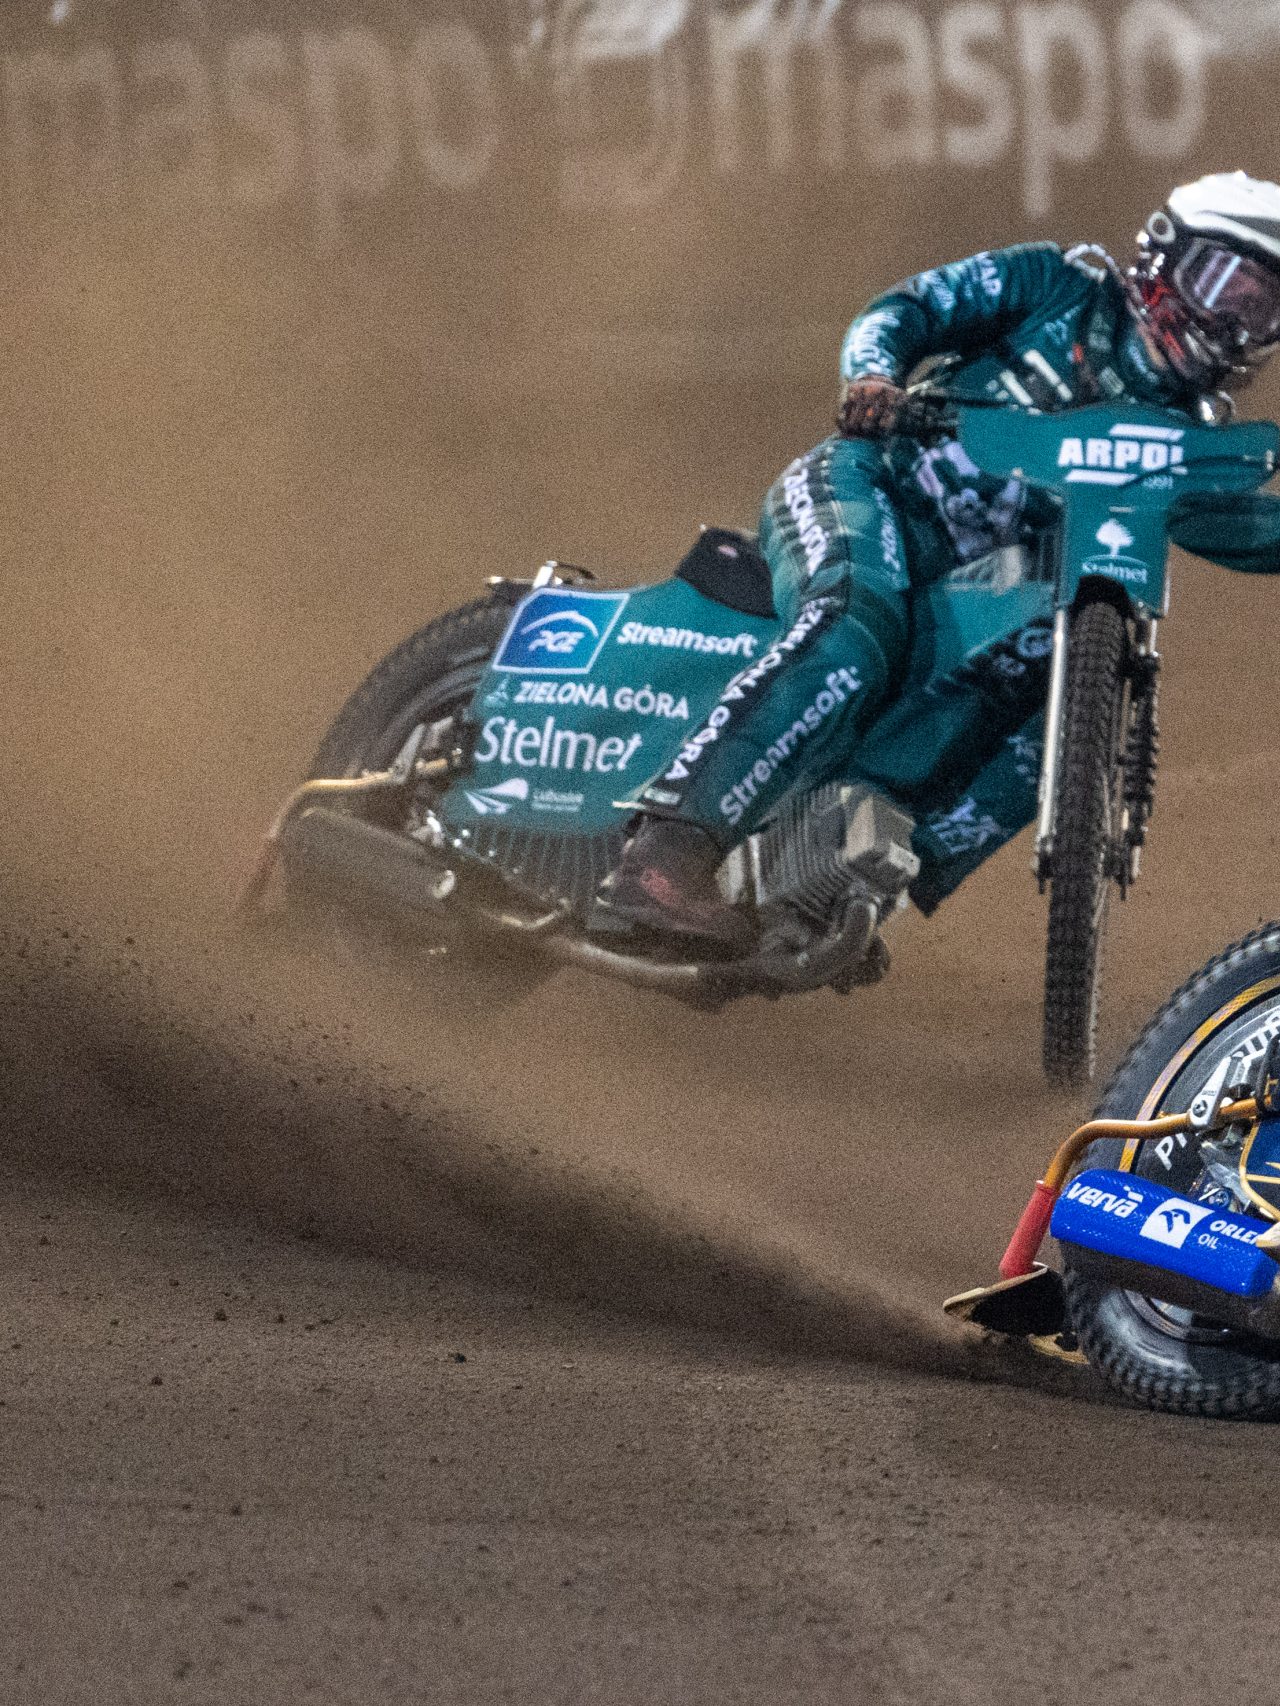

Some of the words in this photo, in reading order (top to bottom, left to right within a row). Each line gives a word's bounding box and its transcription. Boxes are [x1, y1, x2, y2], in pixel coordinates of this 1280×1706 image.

[708, 2, 1202, 216] maspo
[616, 620, 759, 658] Streamsoft
[513, 681, 609, 709] ZIELONA
[614, 684, 690, 720] GÓRA
[473, 715, 643, 772] Stelmet
[1066, 1181, 1140, 1218] verva
[1197, 1233, 1219, 1250] OIL
